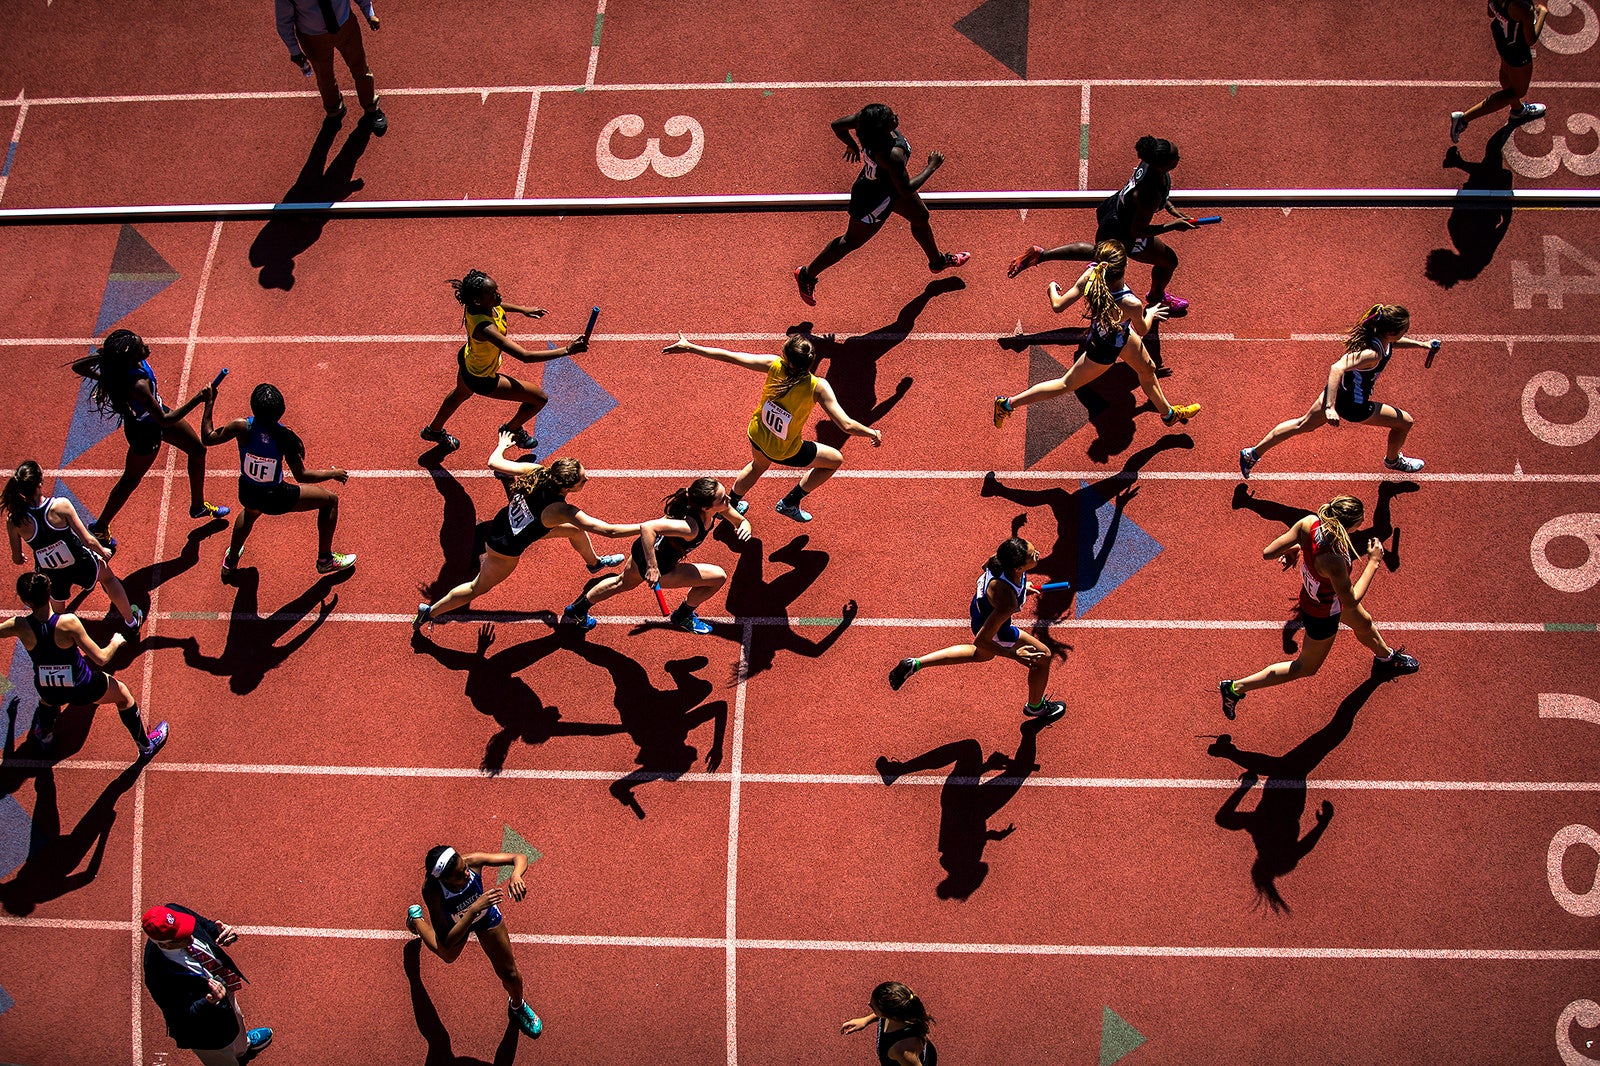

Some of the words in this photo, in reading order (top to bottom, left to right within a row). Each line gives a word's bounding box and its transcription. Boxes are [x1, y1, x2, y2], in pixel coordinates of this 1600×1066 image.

[596, 113, 705, 181] 3
[1501, 112, 1600, 179] 3
[1511, 234, 1600, 310] 4
[765, 409, 784, 433] UG
[249, 461, 269, 480] UF
[43, 551, 69, 568] UL
